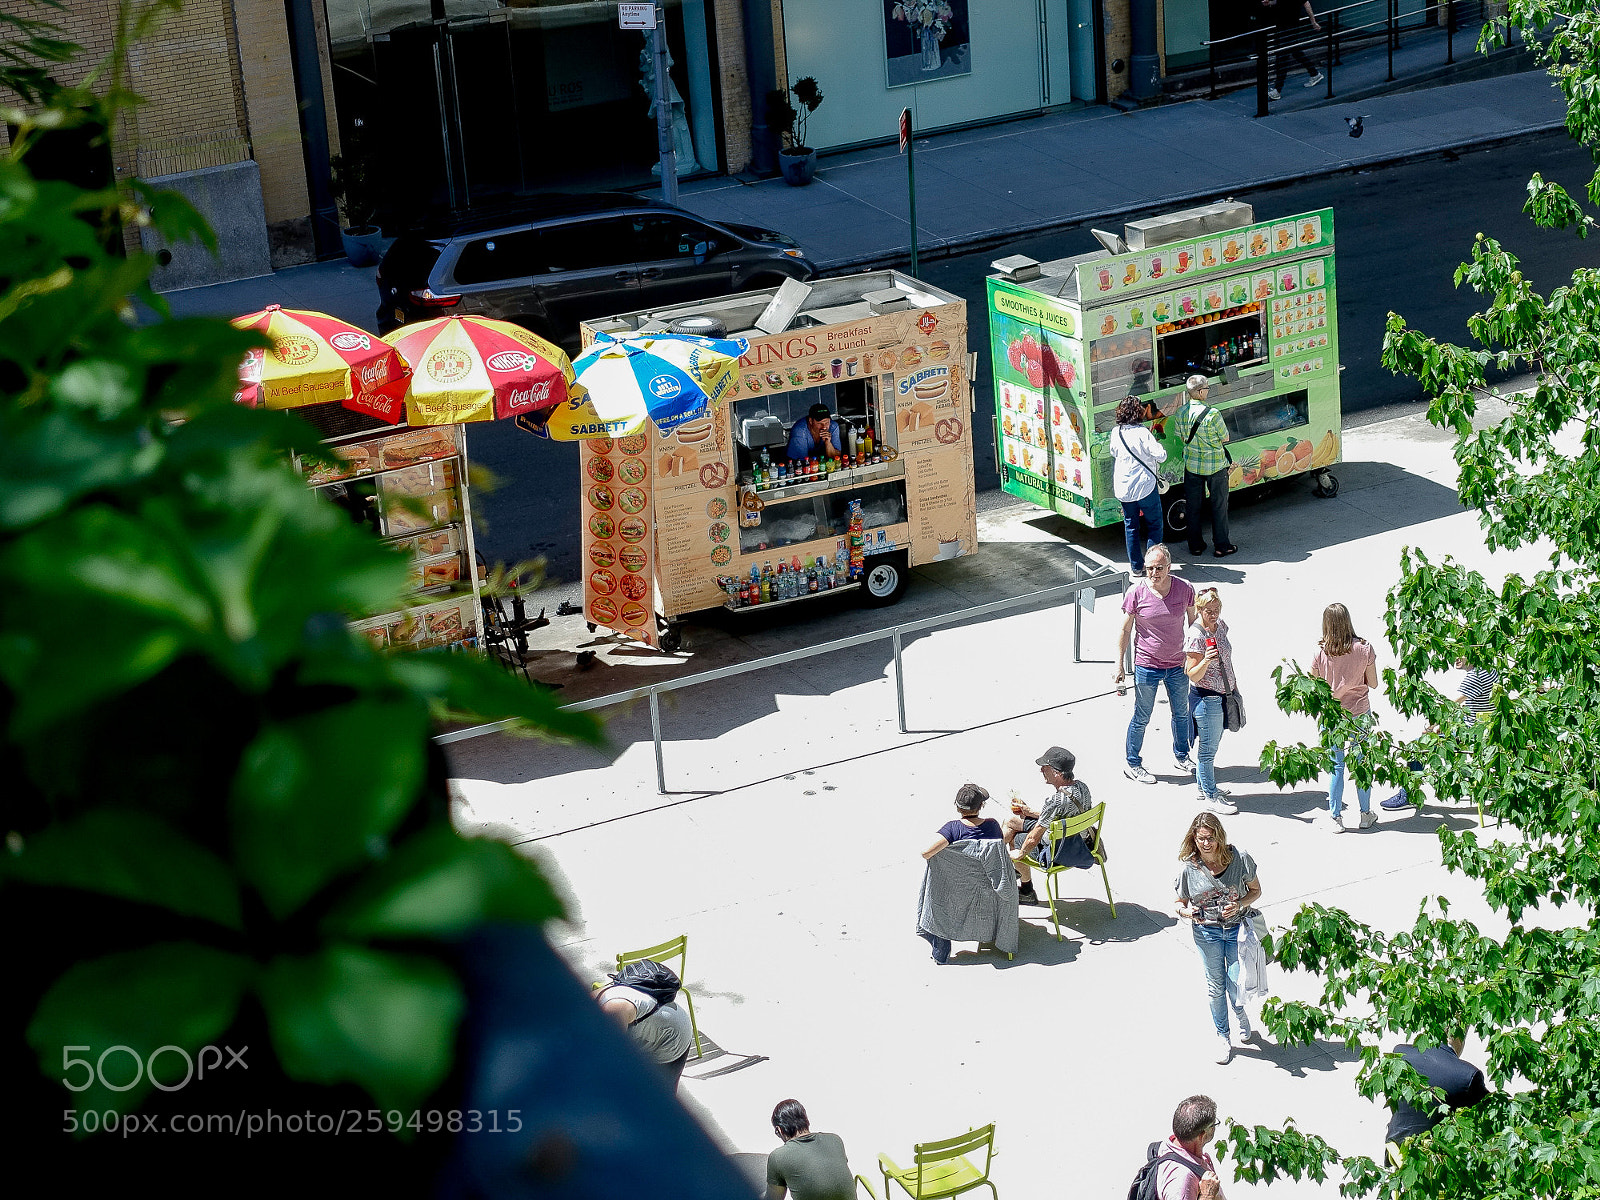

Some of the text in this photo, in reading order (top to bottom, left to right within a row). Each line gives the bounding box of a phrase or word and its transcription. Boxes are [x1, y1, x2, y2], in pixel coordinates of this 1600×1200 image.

[1001, 298, 1068, 326] SMOOTHIES & JUICES
[827, 325, 872, 341] Breakfast
[828, 338, 866, 352] & Lunch
[491, 353, 525, 370] NIKAS
[690, 348, 702, 382] SABRETT
[271, 381, 345, 397] All Beef Sausages
[710, 370, 732, 402] SABRETT
[899, 366, 947, 394] SABRETT
[510, 380, 551, 408] Coca-Cola
[426, 404, 446, 413] Beef
[447, 402, 486, 412] Sausages
[571, 421, 627, 434] SABRETT
[1015, 471, 1044, 491] NATURAL
[1052, 486, 1074, 502] FRESH
